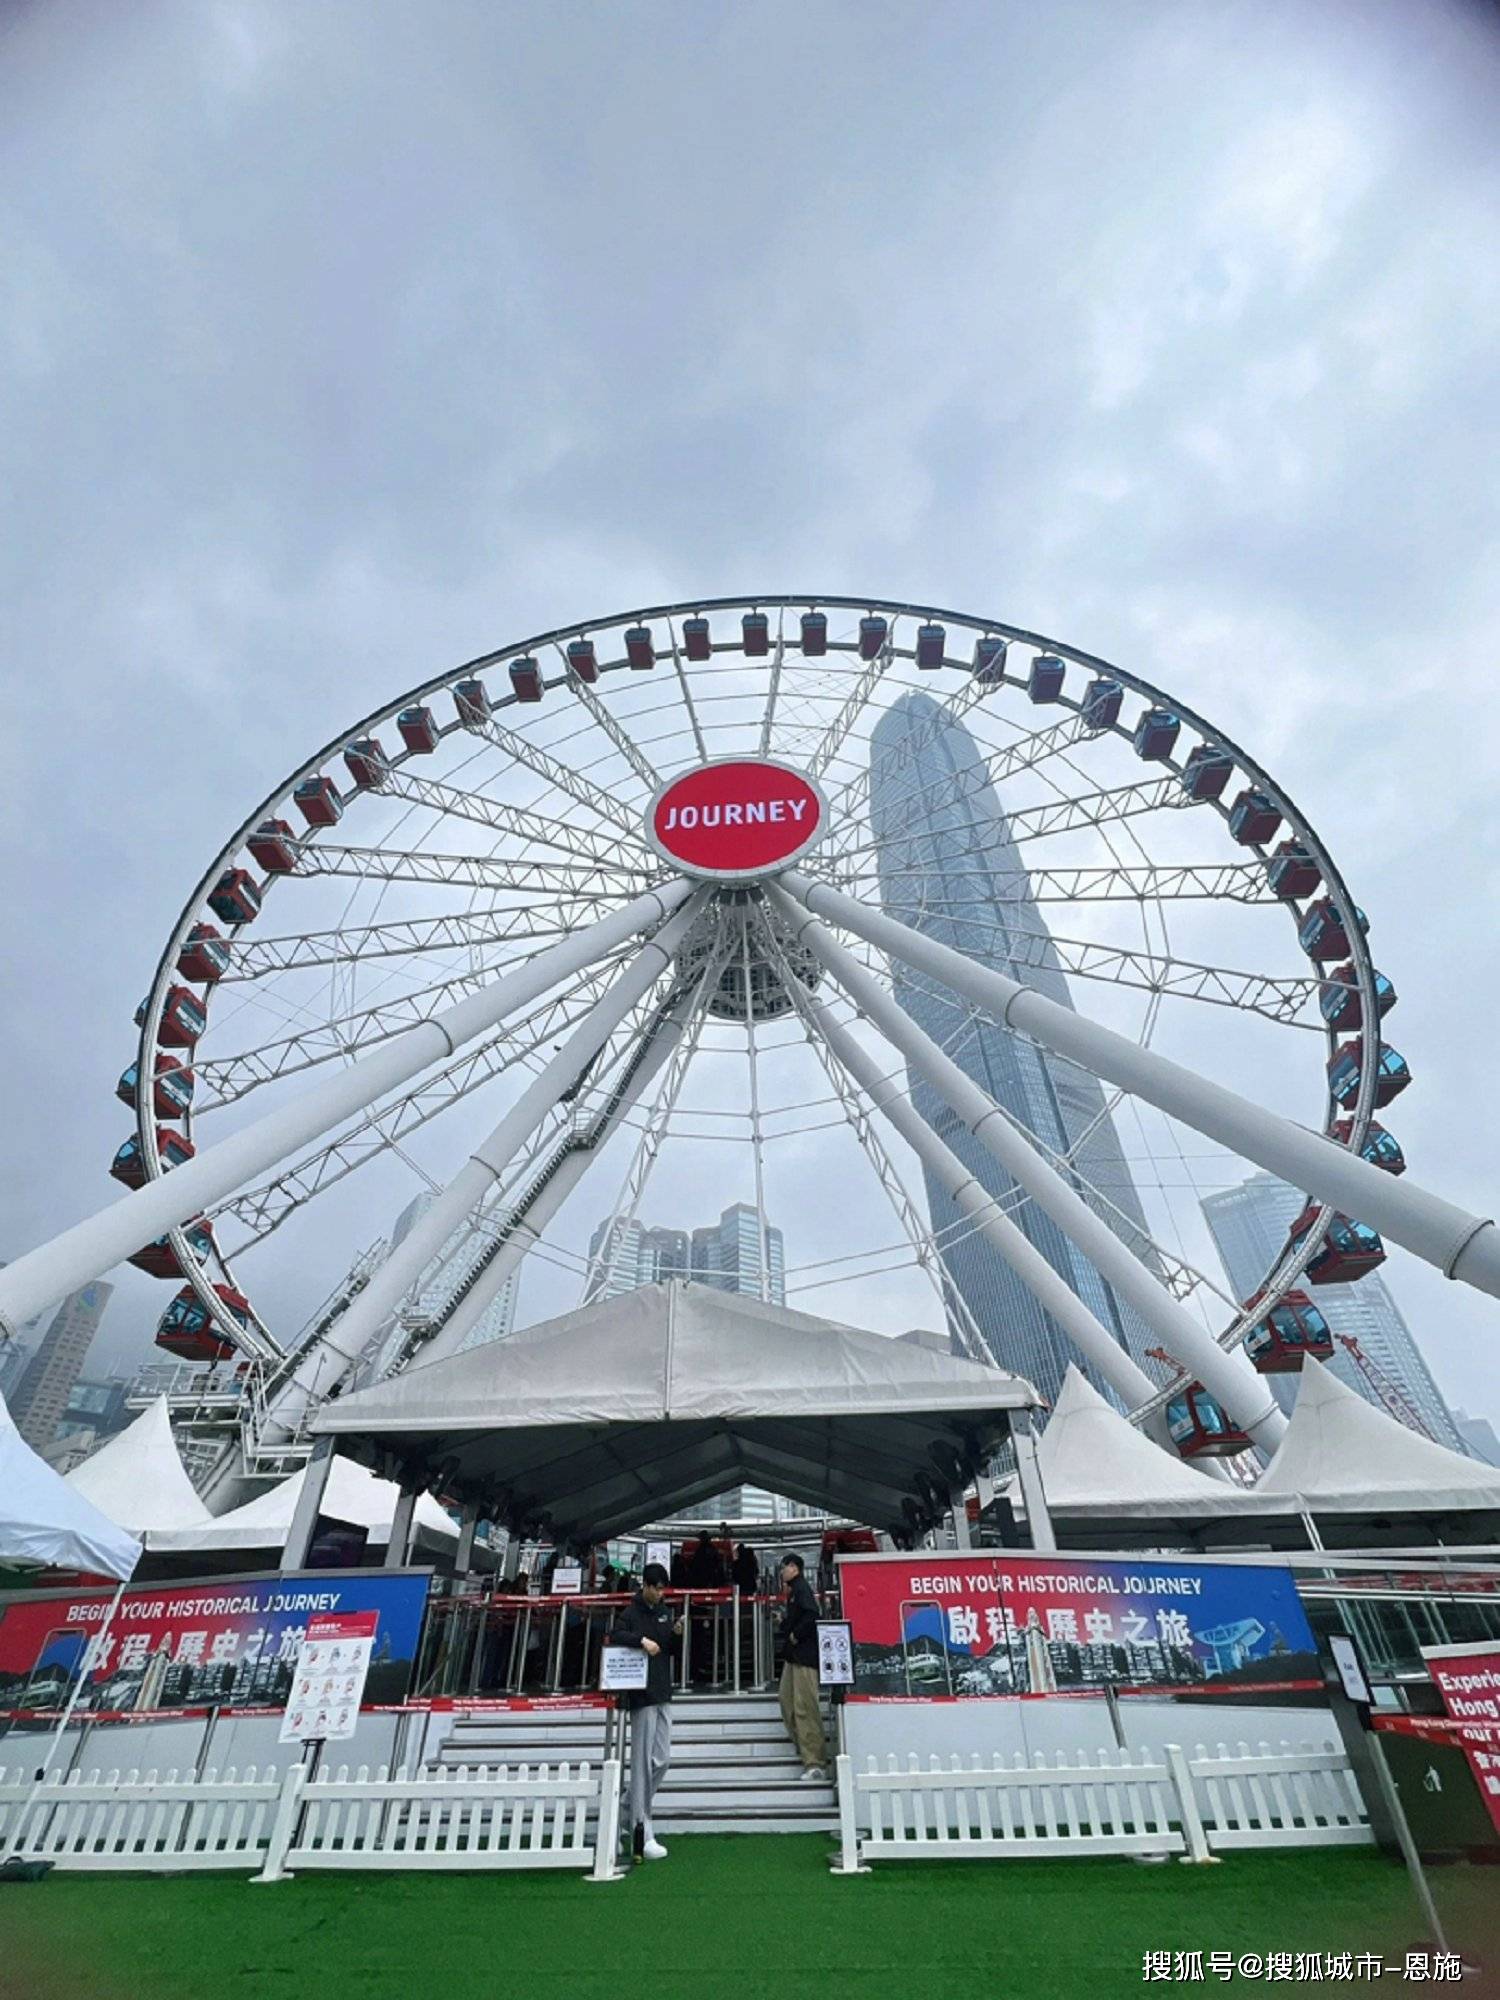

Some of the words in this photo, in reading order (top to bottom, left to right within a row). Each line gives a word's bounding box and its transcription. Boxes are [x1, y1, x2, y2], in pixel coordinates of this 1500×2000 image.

[664, 799, 807, 831] JOURNEY
[910, 1575, 962, 1594] BEGIN
[966, 1575, 1014, 1593] YOUR
[1017, 1575, 1119, 1594] HISTORICAL
[1123, 1577, 1201, 1595] JOURNEY
[120, 1602, 164, 1620] YOUR
[166, 1597, 259, 1618] HISTORICAL
[262, 1593, 341, 1613] JOURNEY
[1449, 1698, 1499, 1718] Hong
